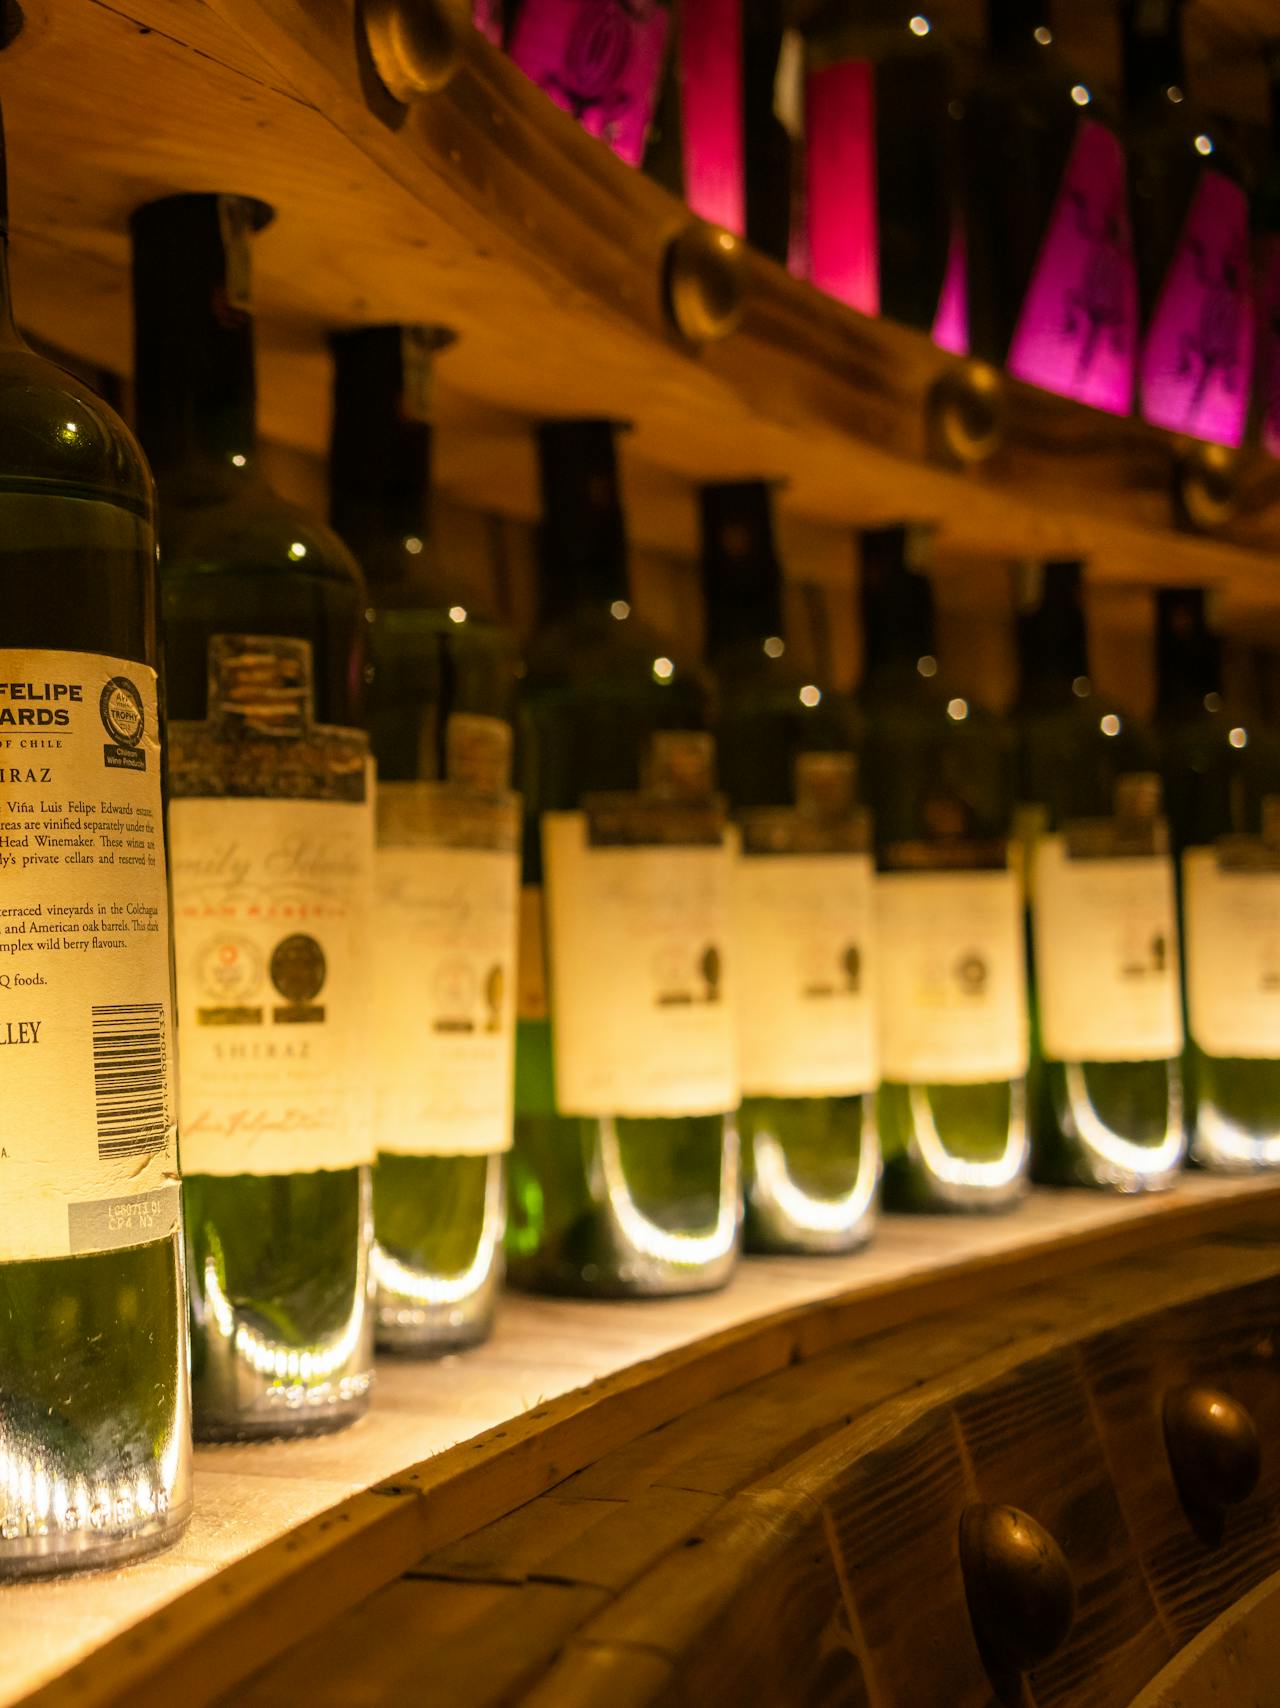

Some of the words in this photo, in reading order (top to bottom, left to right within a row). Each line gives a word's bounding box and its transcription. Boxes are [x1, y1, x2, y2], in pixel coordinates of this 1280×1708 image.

[111, 710, 138, 722] TROPHY
[20, 739, 63, 749] CHILE
[40, 801, 62, 812] Luis
[68, 801, 96, 816] Felipe
[101, 802, 134, 814] Edwards
[24, 820, 40, 830] are
[43, 818, 81, 830] vinified
[83, 820, 125, 833] separately
[126, 822, 144, 833] under
[34, 835, 96, 847] Winemaker.
[100, 835, 124, 847] These
[126, 838, 145, 849] wines
[22, 853, 60, 868] private
[64, 852, 94, 864] cellars
[98, 852, 114, 864] and
[119, 854, 146, 866] reserved
[46, 903, 94, 918] vineyards
[98, 903, 106, 915] in
[110, 903, 123, 914] the
[126, 902, 158, 918] Colchagua
[4, 922, 26, 934] and
[29, 921, 80, 934] American
[82, 920, 99, 932] oak
[101, 920, 130, 932] barrels.
[132, 920, 146, 932] This
[146, 920, 159, 932] dark
[37, 938, 60, 950] wild
[64, 938, 90, 952] berry
[92, 936, 128, 948] flavours.
[14, 973, 48, 986] foods.
